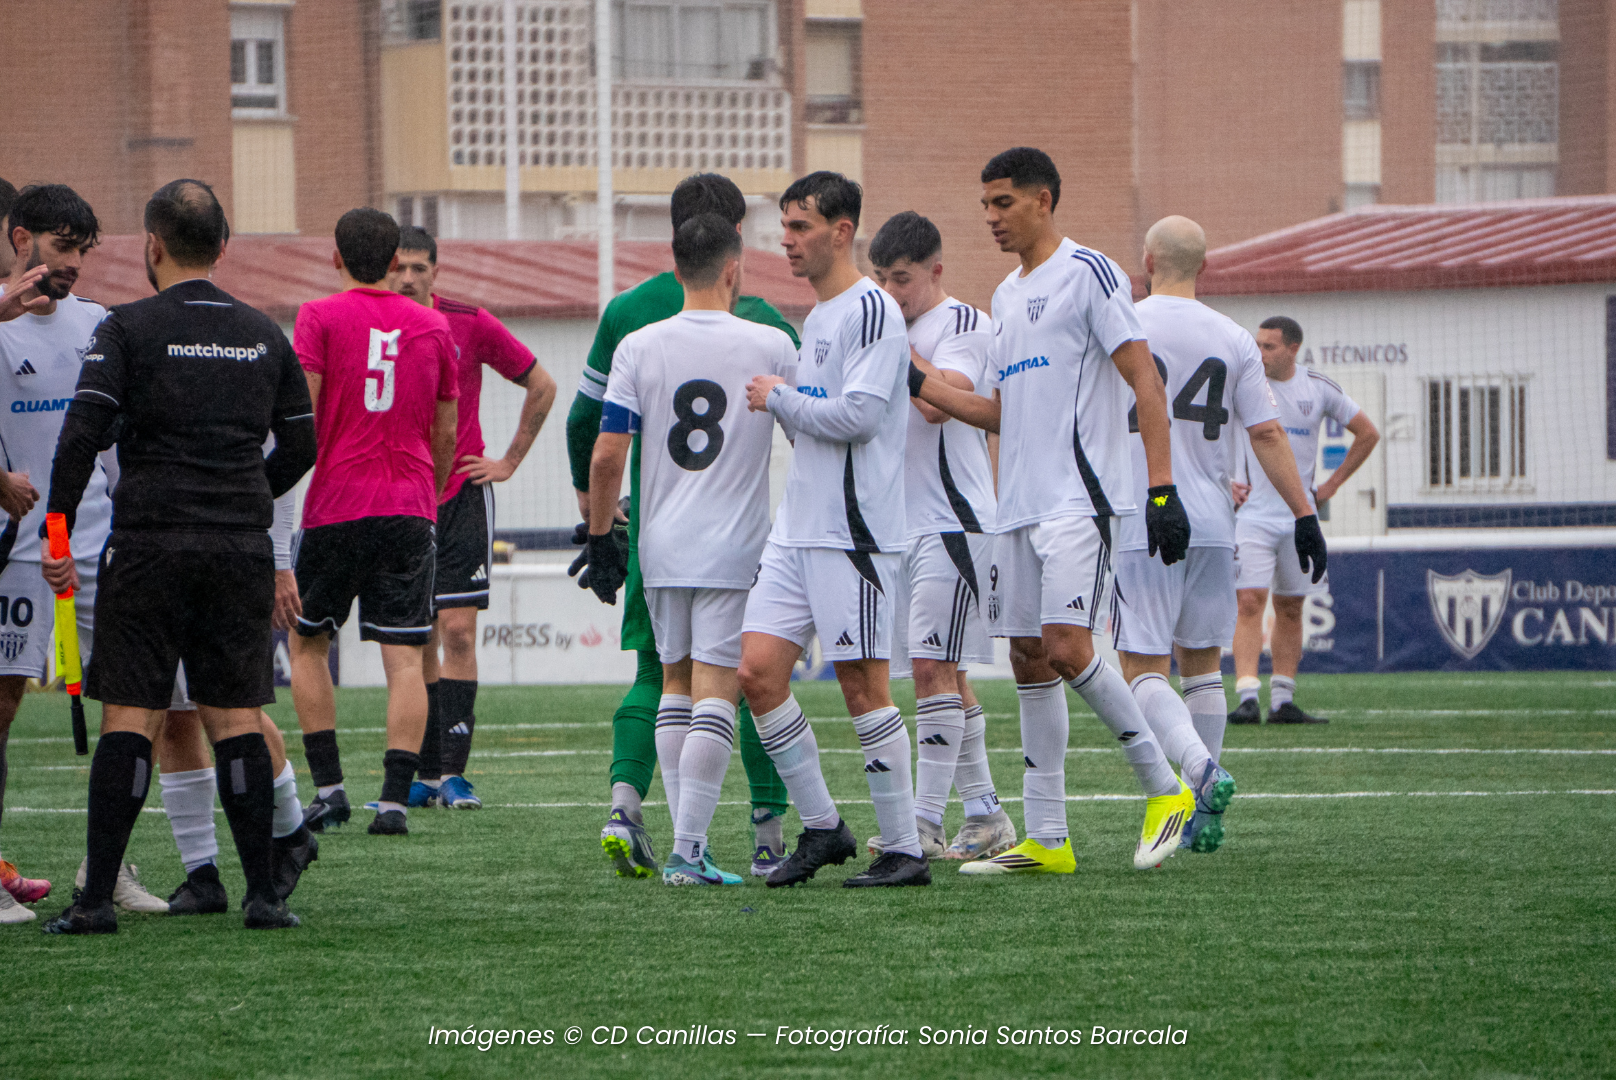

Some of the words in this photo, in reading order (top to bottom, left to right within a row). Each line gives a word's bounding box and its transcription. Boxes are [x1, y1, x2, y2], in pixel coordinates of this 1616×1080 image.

[167, 343, 258, 361] matchapp
[364, 328, 401, 412] 5
[667, 379, 728, 471] 8
[990, 564, 998, 591] 9
[1512, 580, 1560, 600] Club
[482, 624, 550, 648] PRESS
[555, 630, 574, 650] by
